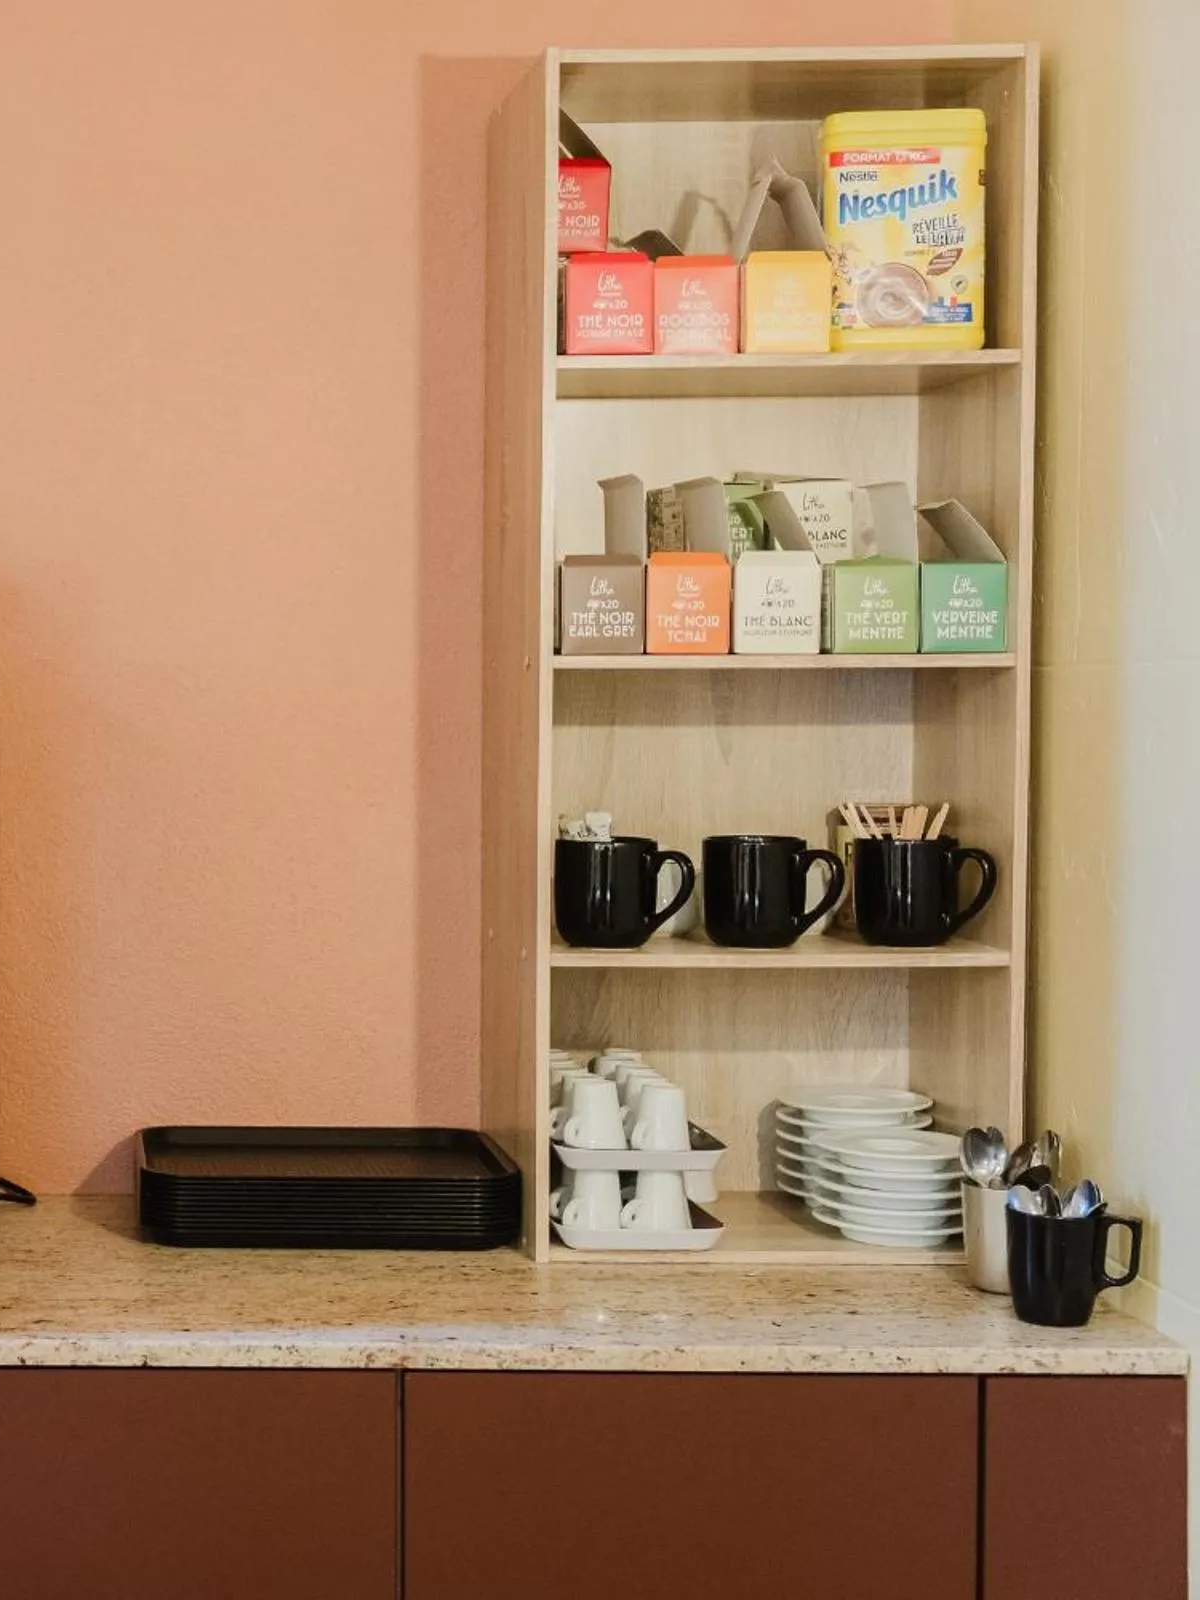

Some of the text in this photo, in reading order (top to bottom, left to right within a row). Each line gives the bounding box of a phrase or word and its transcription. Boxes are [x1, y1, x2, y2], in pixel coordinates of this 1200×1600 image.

[843, 152, 891, 164] FORMAT
[839, 168, 958, 225] Nesquik
[565, 214, 601, 228] NOIR
[607, 313, 644, 328] NOIR
[731, 527, 755, 540] ERT
[599, 611, 635, 625] NOIR
[685, 615, 720, 628] NOIR
[769, 615, 813, 627] BLANC
[874, 611, 909, 625] VERT
[932, 610, 999, 624] VERVEINE
[569, 624, 636, 638] EARL GREY
[668, 630, 707, 643] TCHAI
[848, 627, 904, 640] MENTHE
[936, 625, 994, 639] MENTHE
